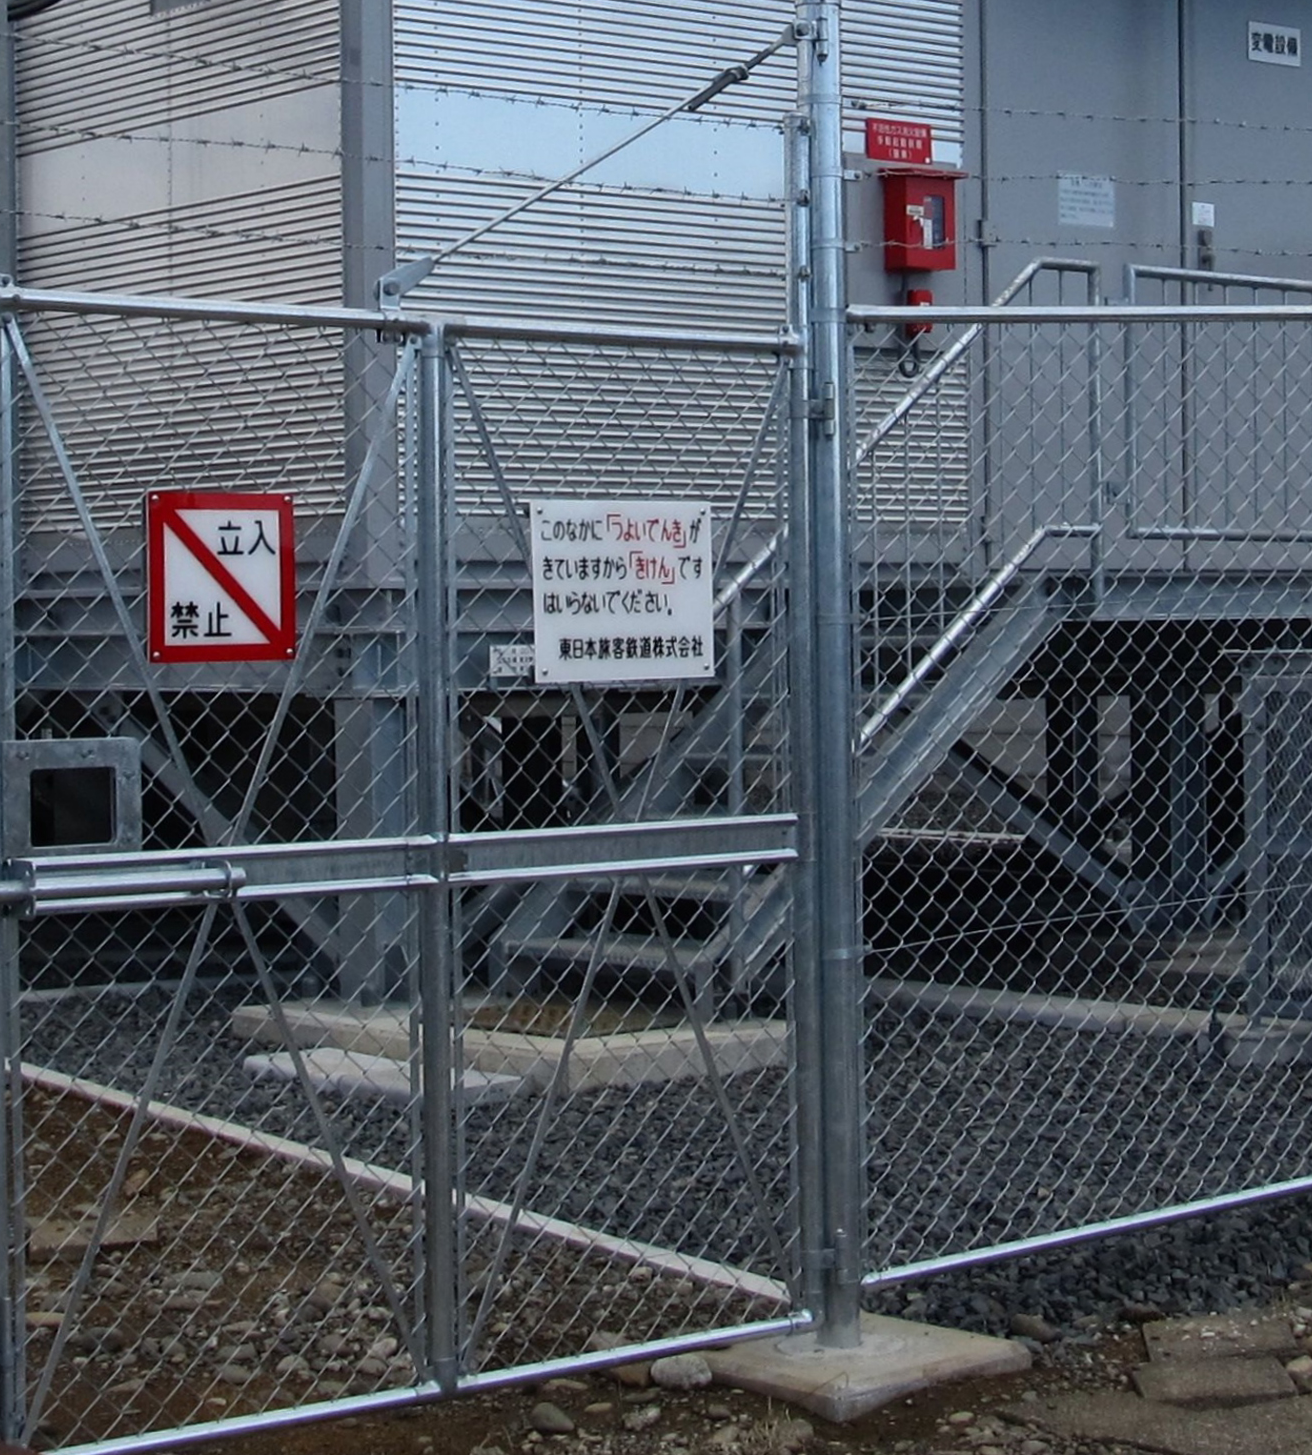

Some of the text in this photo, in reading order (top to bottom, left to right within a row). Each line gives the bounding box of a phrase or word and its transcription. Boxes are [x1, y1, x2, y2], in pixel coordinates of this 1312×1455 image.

[217, 520, 276, 555] 立入
[543, 589, 673, 616] はいらないでください。
[171, 601, 232, 639] 禁止
[559, 635, 704, 661] 東日本旅客鉄道株式会社
